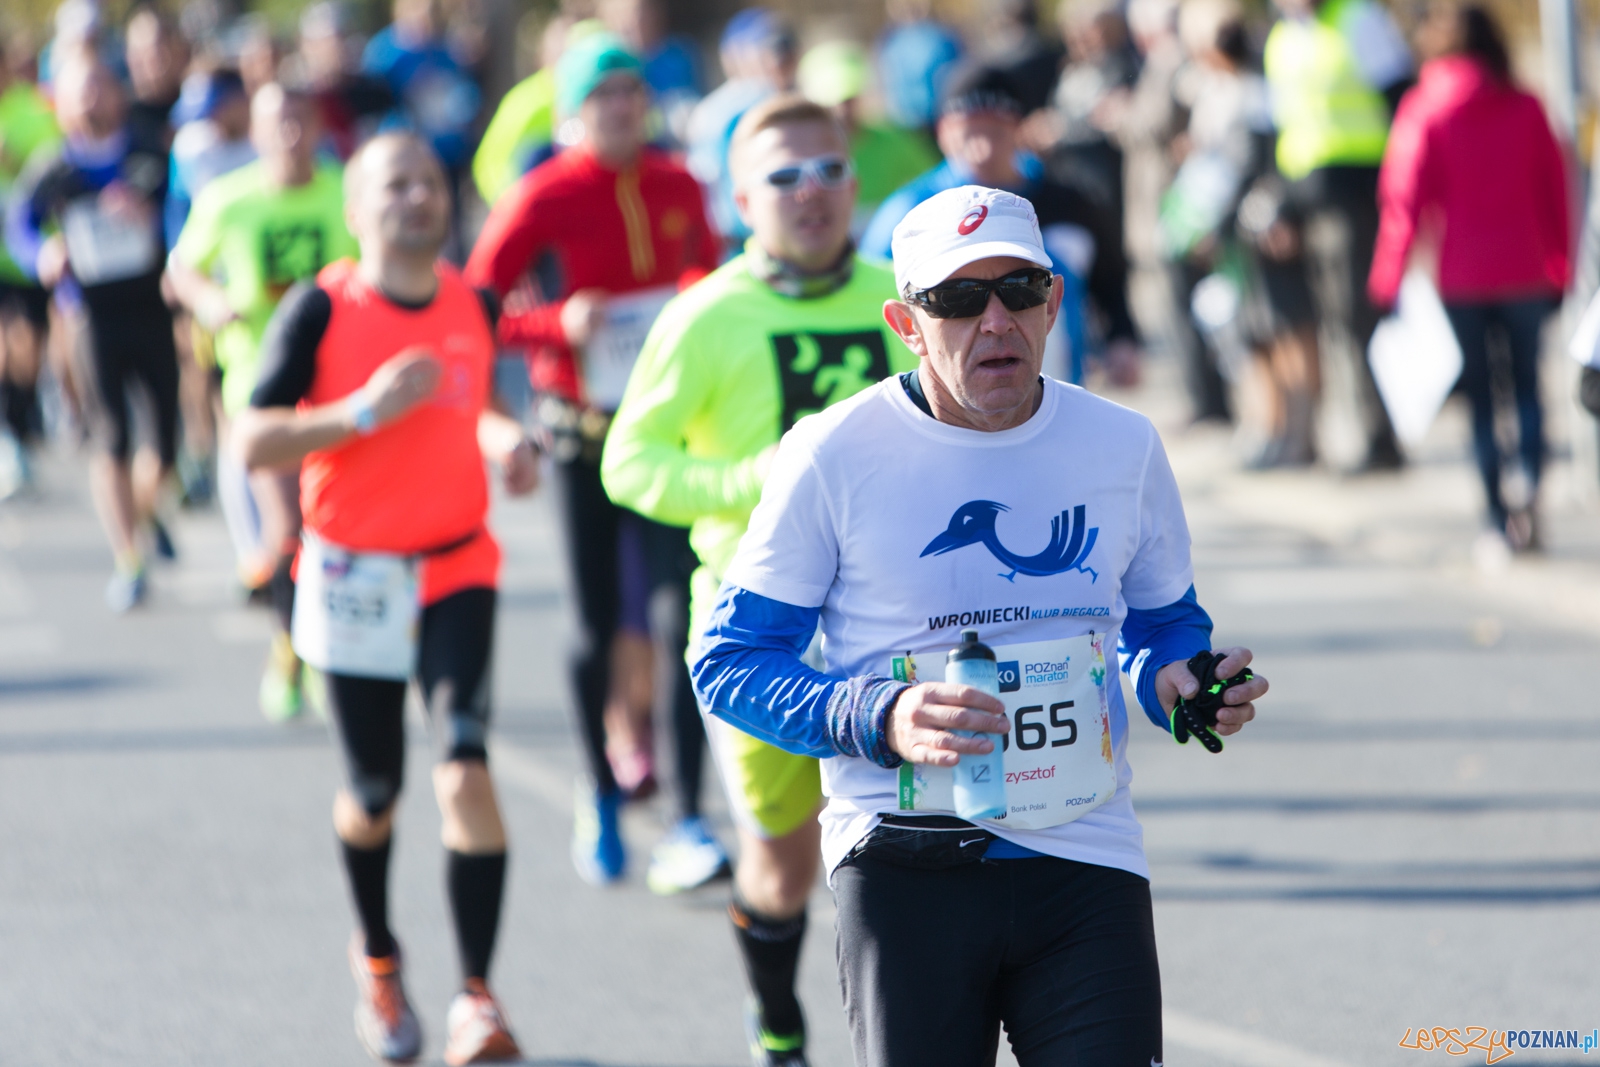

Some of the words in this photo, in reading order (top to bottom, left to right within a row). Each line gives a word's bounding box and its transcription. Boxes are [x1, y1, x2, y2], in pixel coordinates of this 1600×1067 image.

[928, 606, 1030, 630] WRONIECKI
[1031, 608, 1060, 620] KLUB
[1061, 607, 1111, 617] BIEGACZA
[997, 669, 1015, 683] KO
[1026, 671, 1068, 684] maraton
[1003, 700, 1078, 753] 65
[1005, 765, 1056, 784] zysztof
[1011, 804, 1027, 813] Bank
[1029, 802, 1047, 811] Polski
